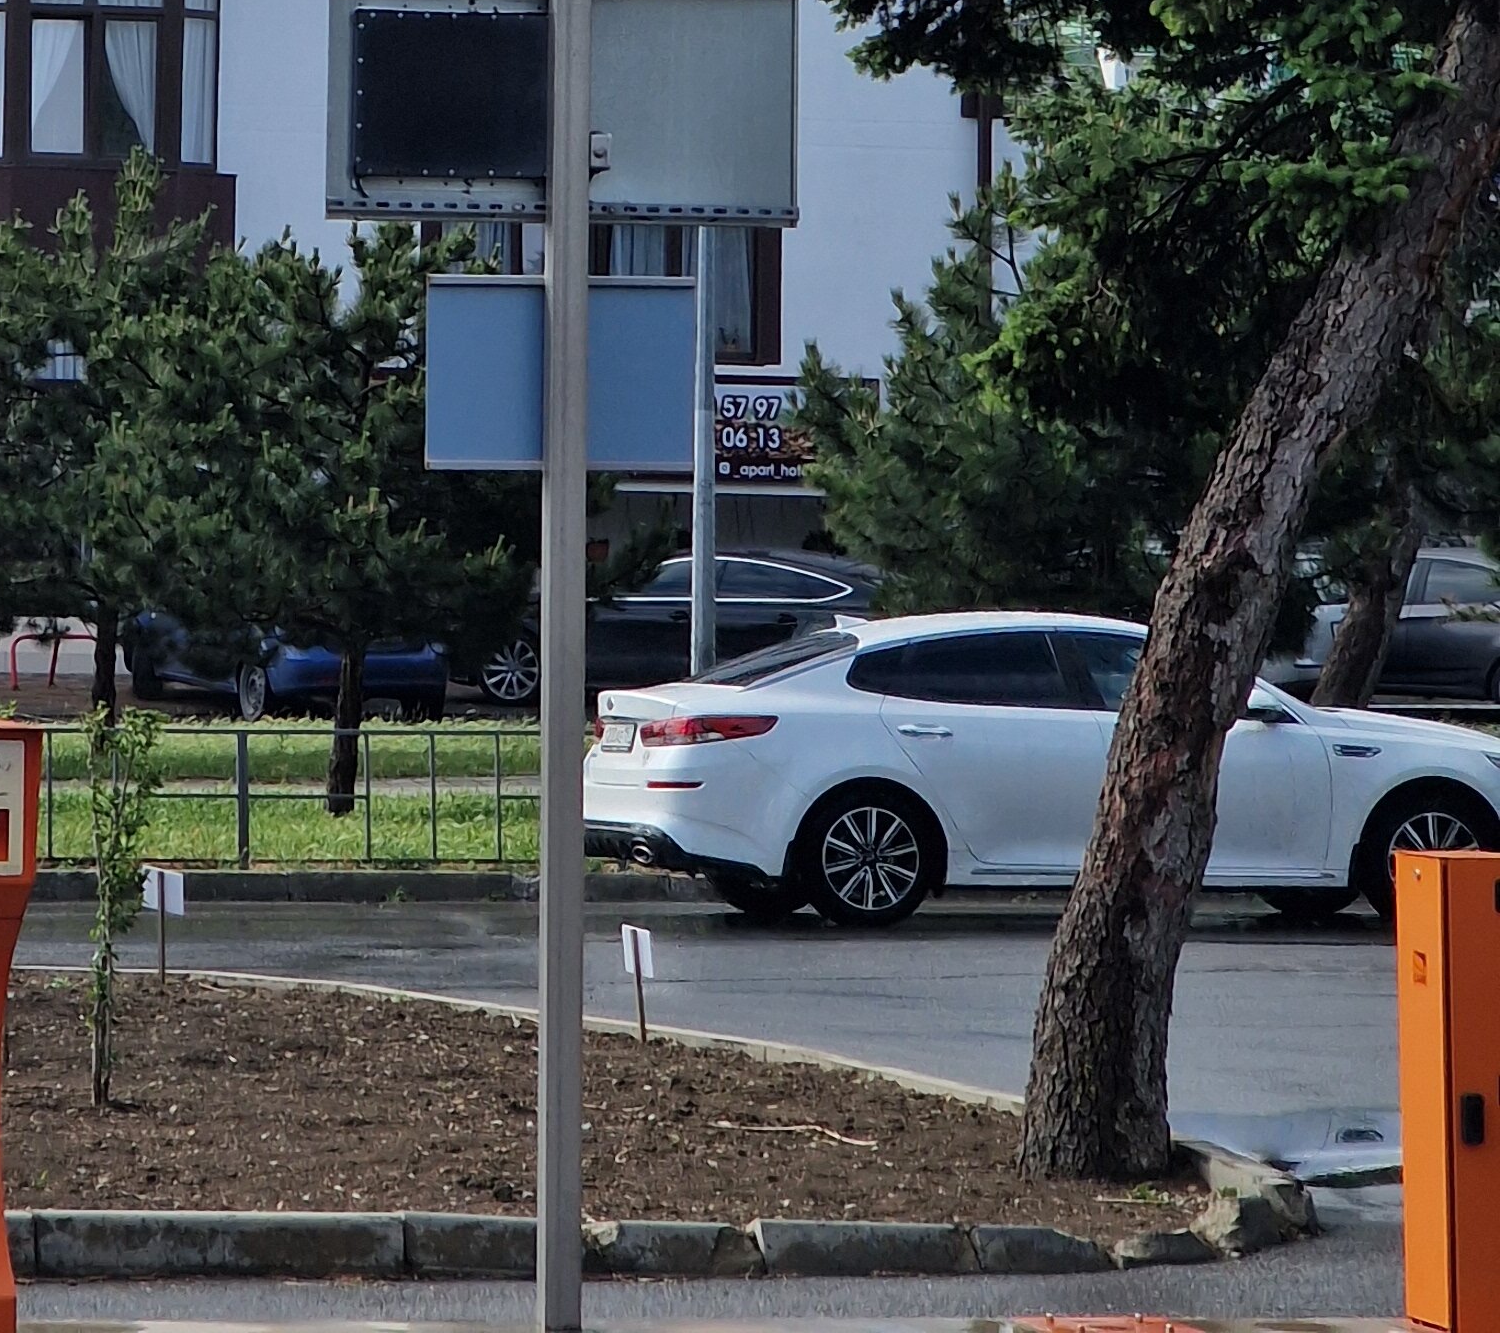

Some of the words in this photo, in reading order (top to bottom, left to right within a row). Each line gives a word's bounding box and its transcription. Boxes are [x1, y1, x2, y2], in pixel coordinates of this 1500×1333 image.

[722, 397, 747, 418] 57
[755, 398, 780, 419] 97
[722, 426, 748, 448] 06
[757, 427, 780, 449] 13
